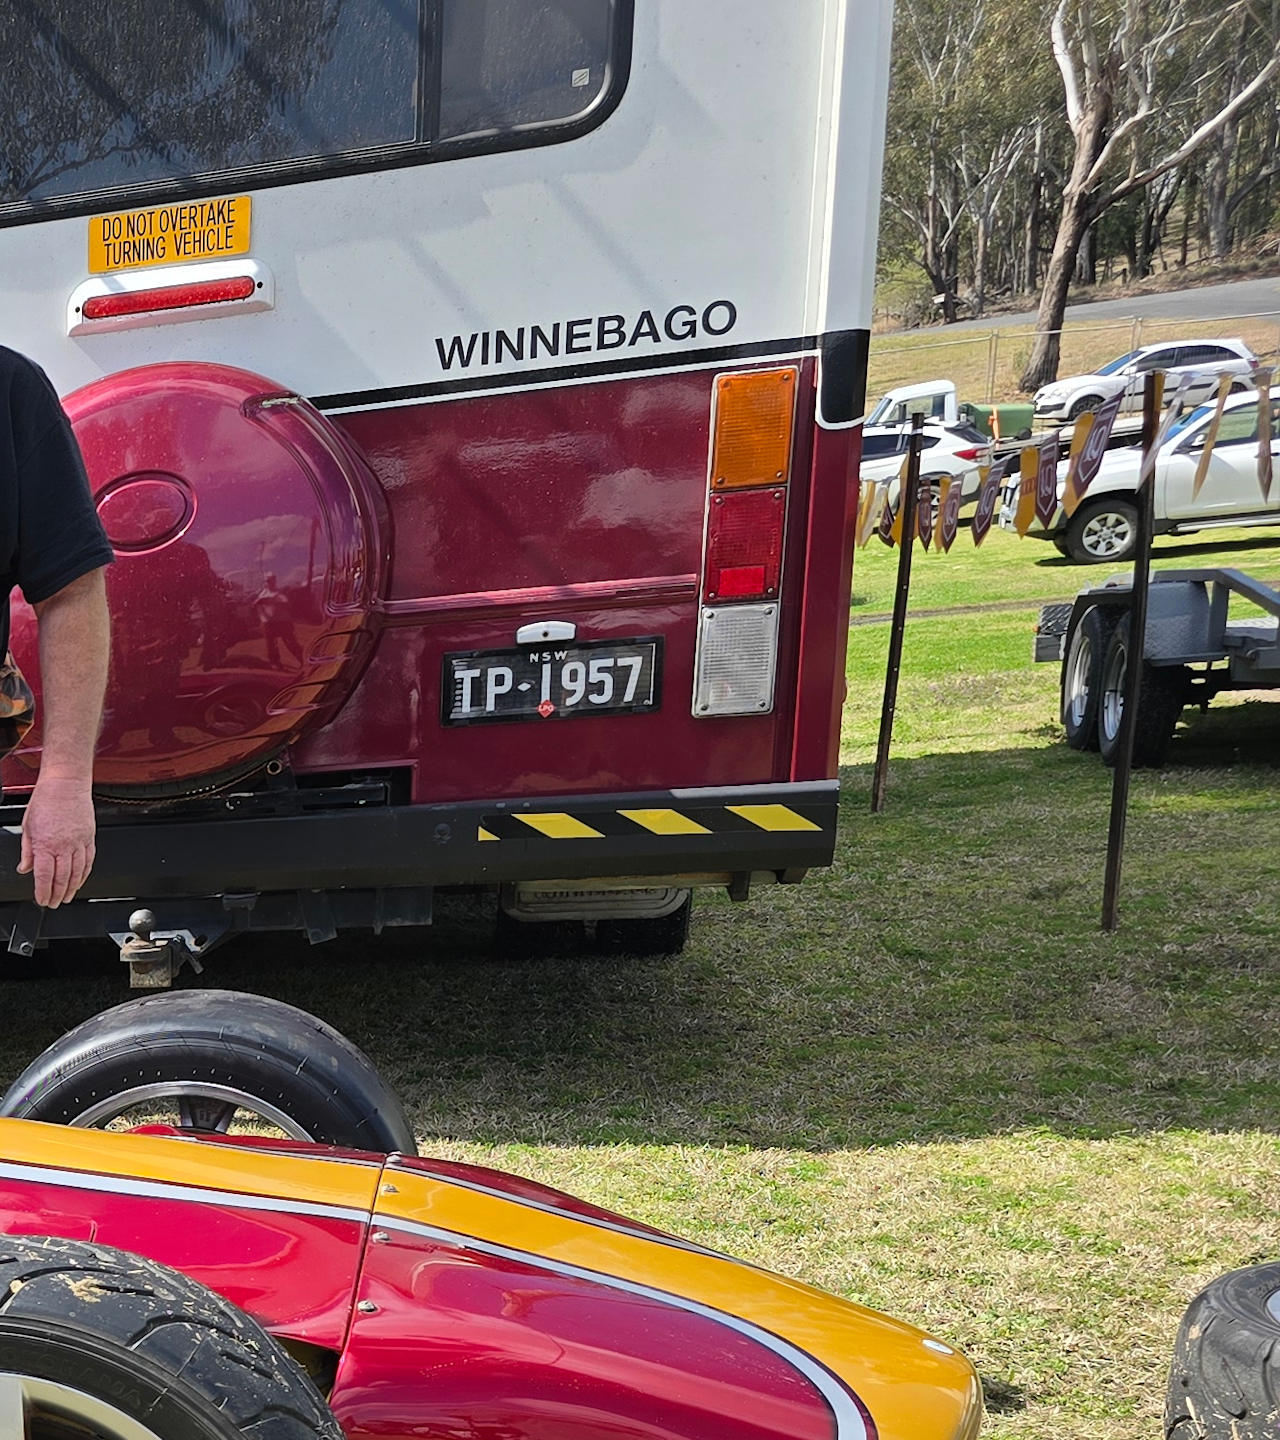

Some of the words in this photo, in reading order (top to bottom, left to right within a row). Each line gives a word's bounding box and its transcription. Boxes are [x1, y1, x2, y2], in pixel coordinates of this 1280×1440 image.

[102, 217, 122, 242] DO
[126, 211, 155, 238] NOT
[159, 199, 236, 233] OVERTAKE
[104, 236, 166, 267] TURNING
[173, 225, 234, 257] VEHICLE
[434, 299, 738, 371] WINNEBAGO
[529, 650, 568, 663] NSW
